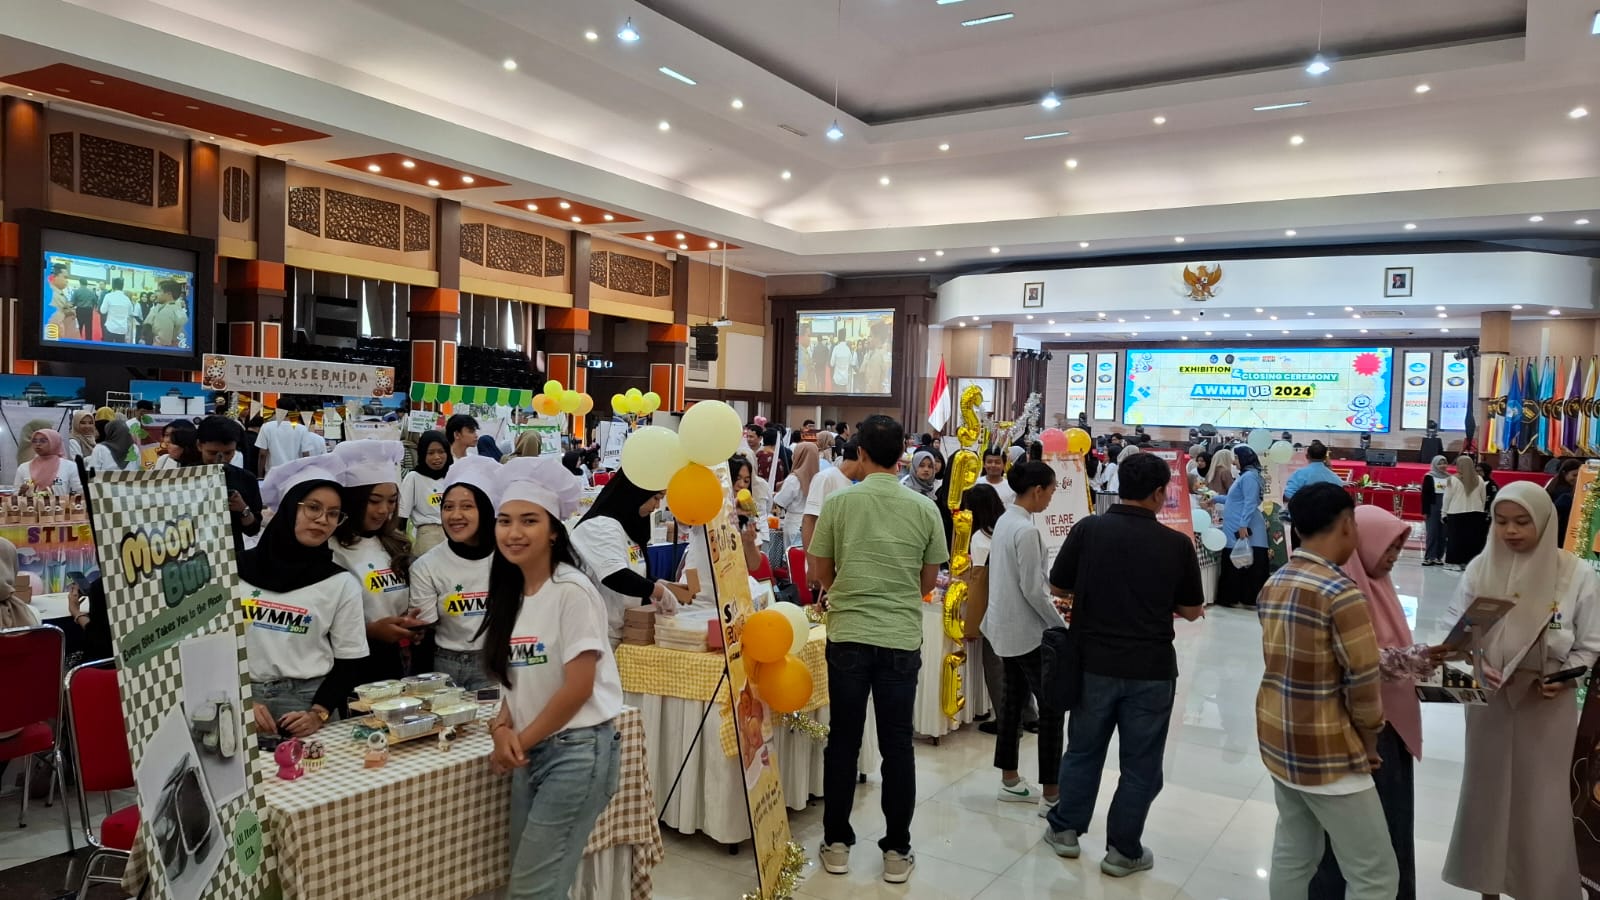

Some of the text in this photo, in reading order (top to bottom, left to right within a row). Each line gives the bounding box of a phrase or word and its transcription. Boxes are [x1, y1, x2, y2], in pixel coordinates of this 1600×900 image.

[1241, 373, 1338, 381] CLOSING CEREMONY
[1194, 385, 1312, 397] AWMM UB 2024
[1045, 514, 1074, 526] WE ARE
[121, 514, 196, 588] Moon
[370, 574, 406, 590] AWM
[447, 598, 489, 612] AWM
[122, 644, 142, 662] Every
[155, 620, 176, 639] Takes
[176, 614, 189, 627] You
